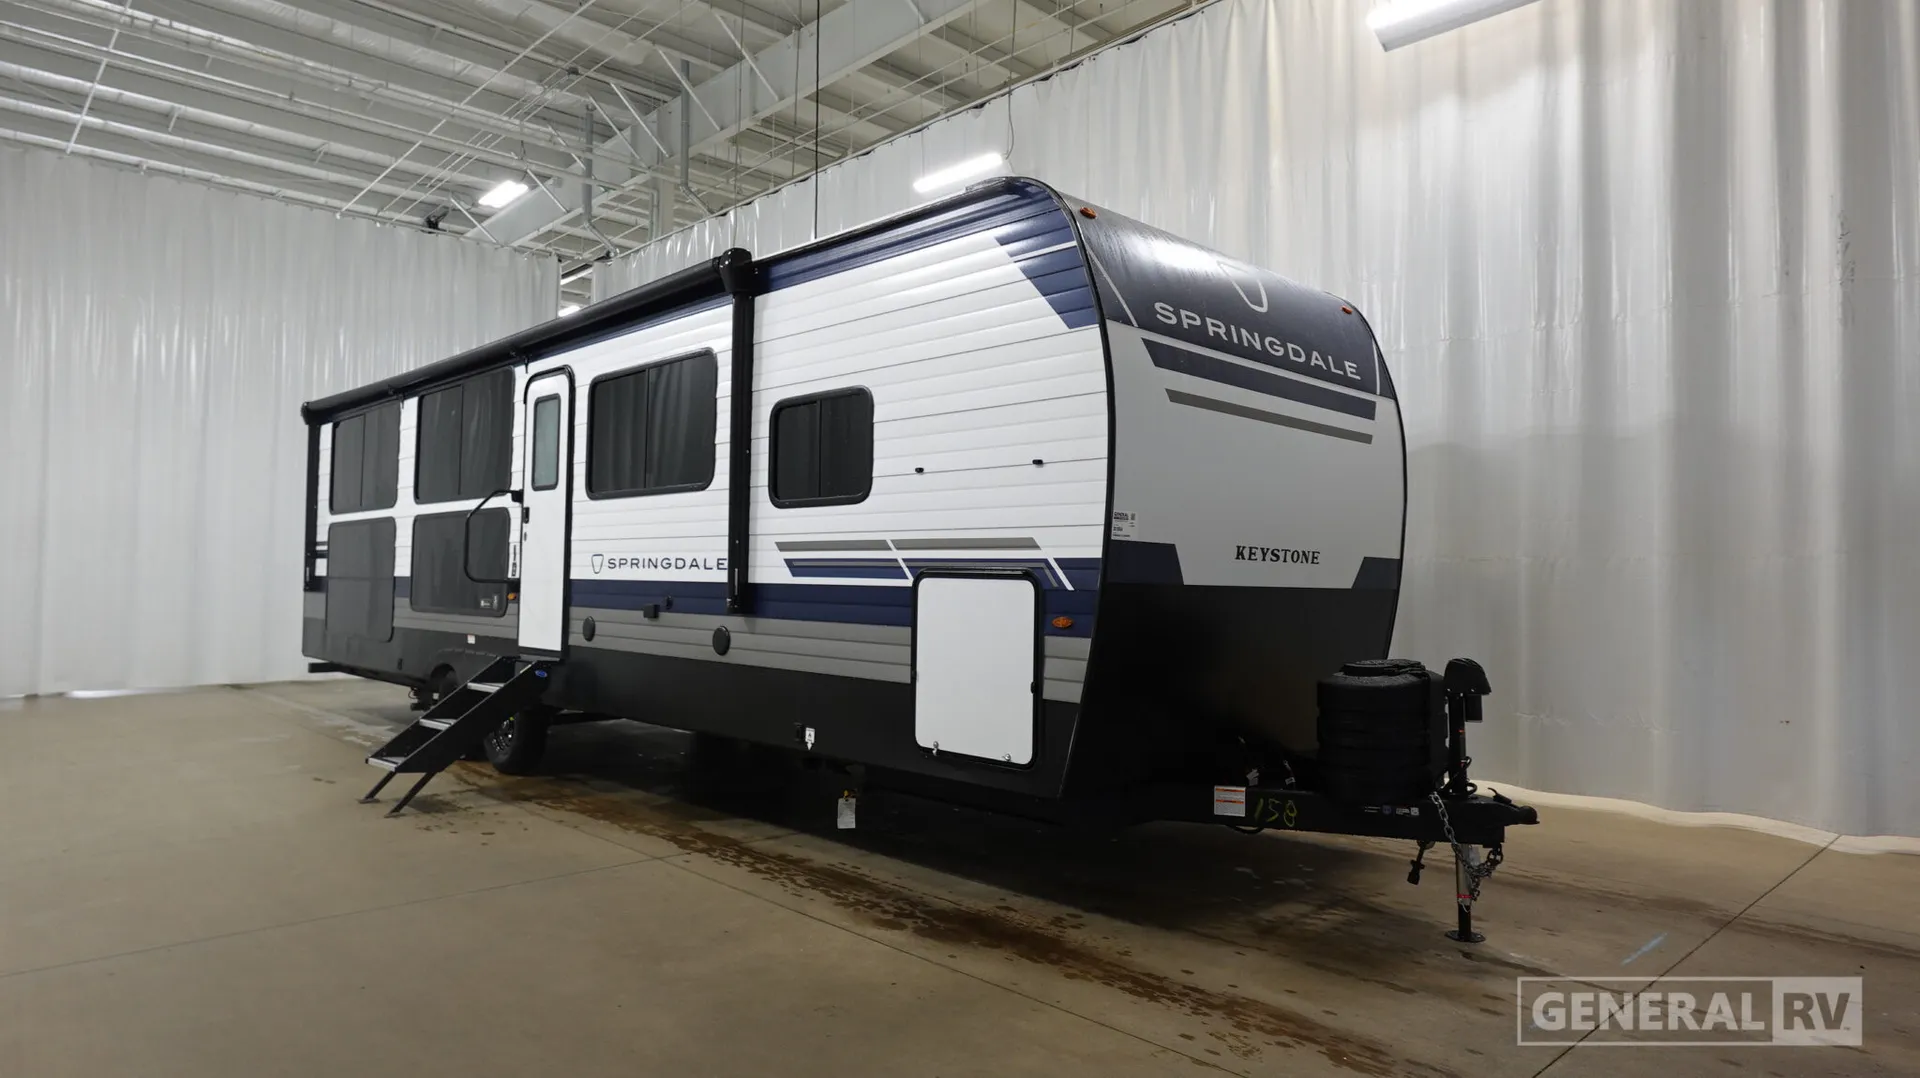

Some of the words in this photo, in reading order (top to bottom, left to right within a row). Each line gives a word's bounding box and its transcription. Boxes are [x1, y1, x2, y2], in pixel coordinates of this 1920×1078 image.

[1154, 302, 1361, 379] SPRINGDALE
[607, 557, 728, 570] SPRINGDALE
[1235, 545, 1320, 564] KEYSTONE
[1254, 798, 1298, 827] 158
